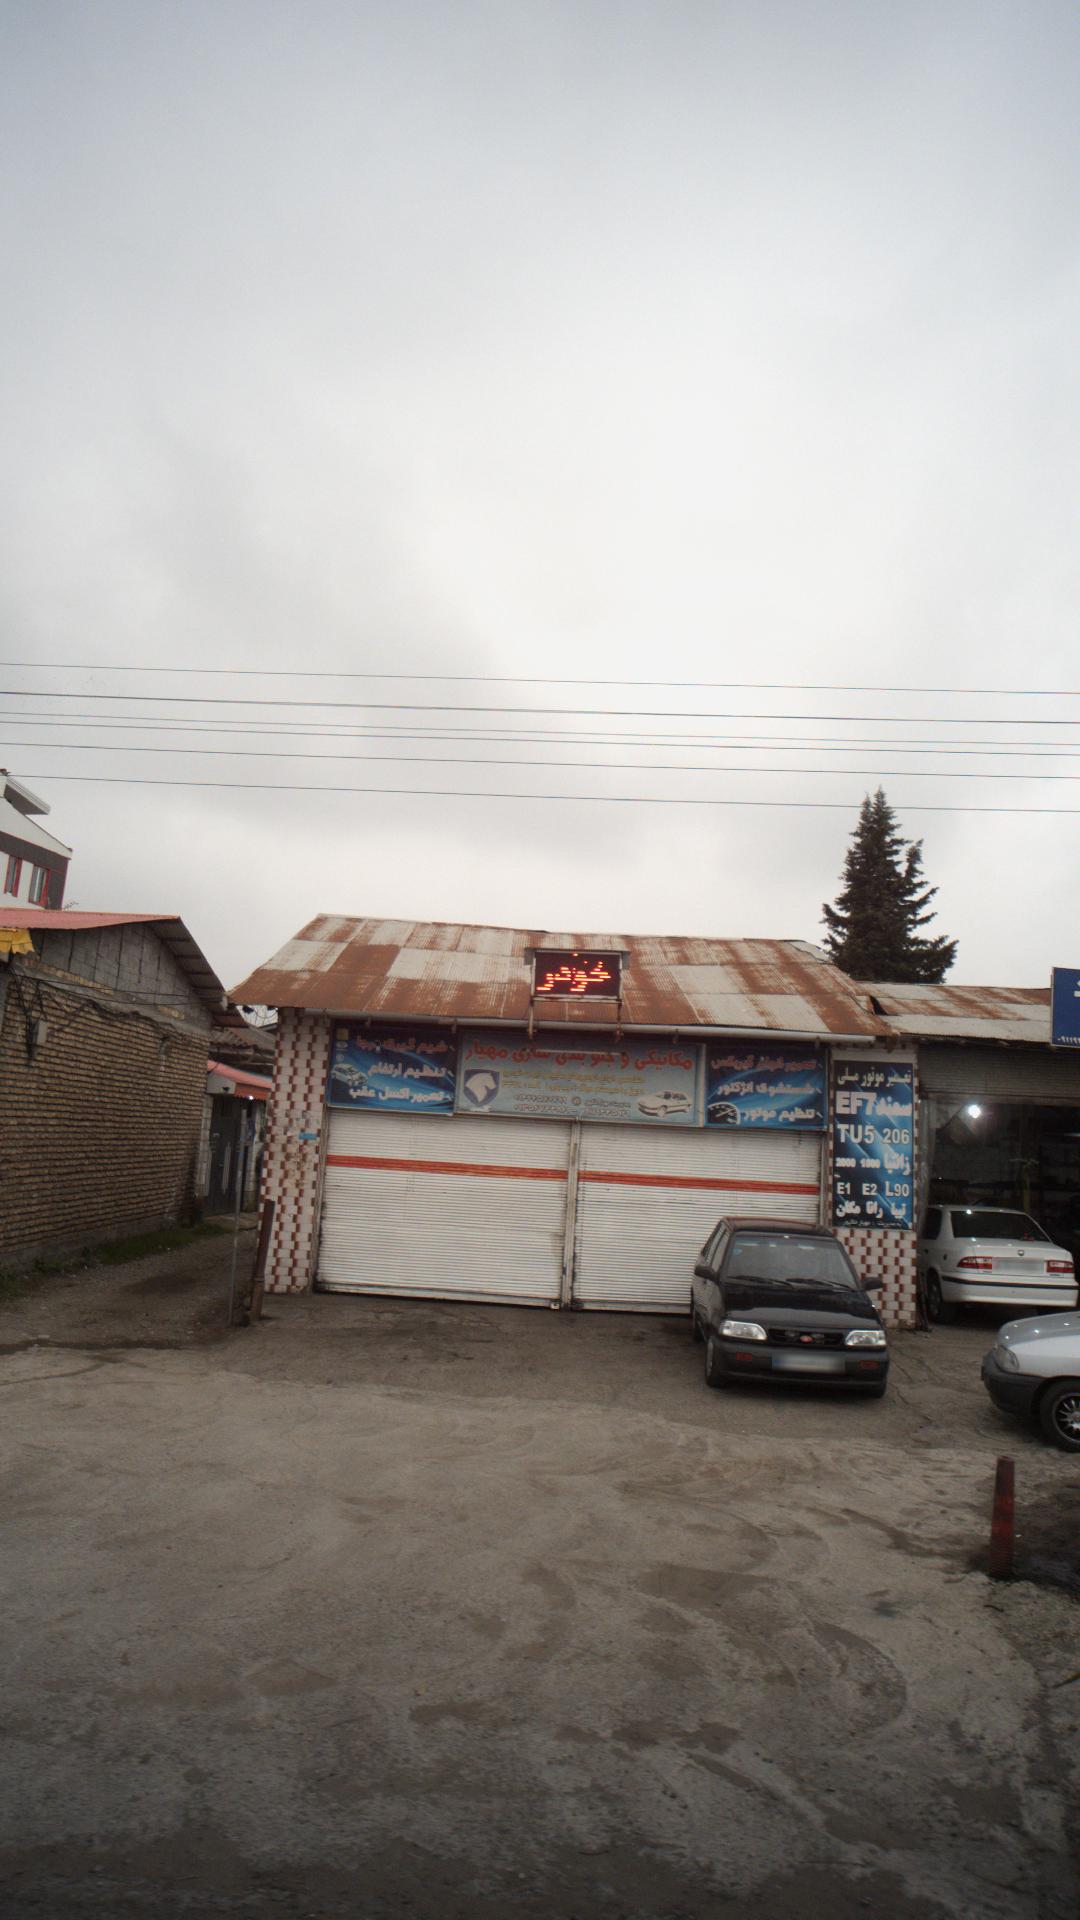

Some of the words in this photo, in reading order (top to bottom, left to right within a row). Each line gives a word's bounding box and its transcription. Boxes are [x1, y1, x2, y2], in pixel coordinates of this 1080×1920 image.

[634, 1049, 693, 1071] مکانیکی
[403, 1063, 448, 1079] تنظیم
[860, 1066, 885, 1088] موتور
[348, 1086, 377, 1099] عقب
[410, 1091, 446, 1104] تعمیر
[835, 1090, 877, 1116] EF7
[741, 1107, 777, 1122] موتور
[778, 1106, 816, 1122] تنظیم
[837, 1123, 876, 1145] TU5
[882, 1127, 910, 1145] 206
[836, 1181, 851, 1195] E1
[861, 1182, 878, 1196] E2
[884, 1180, 910, 1197] L90
